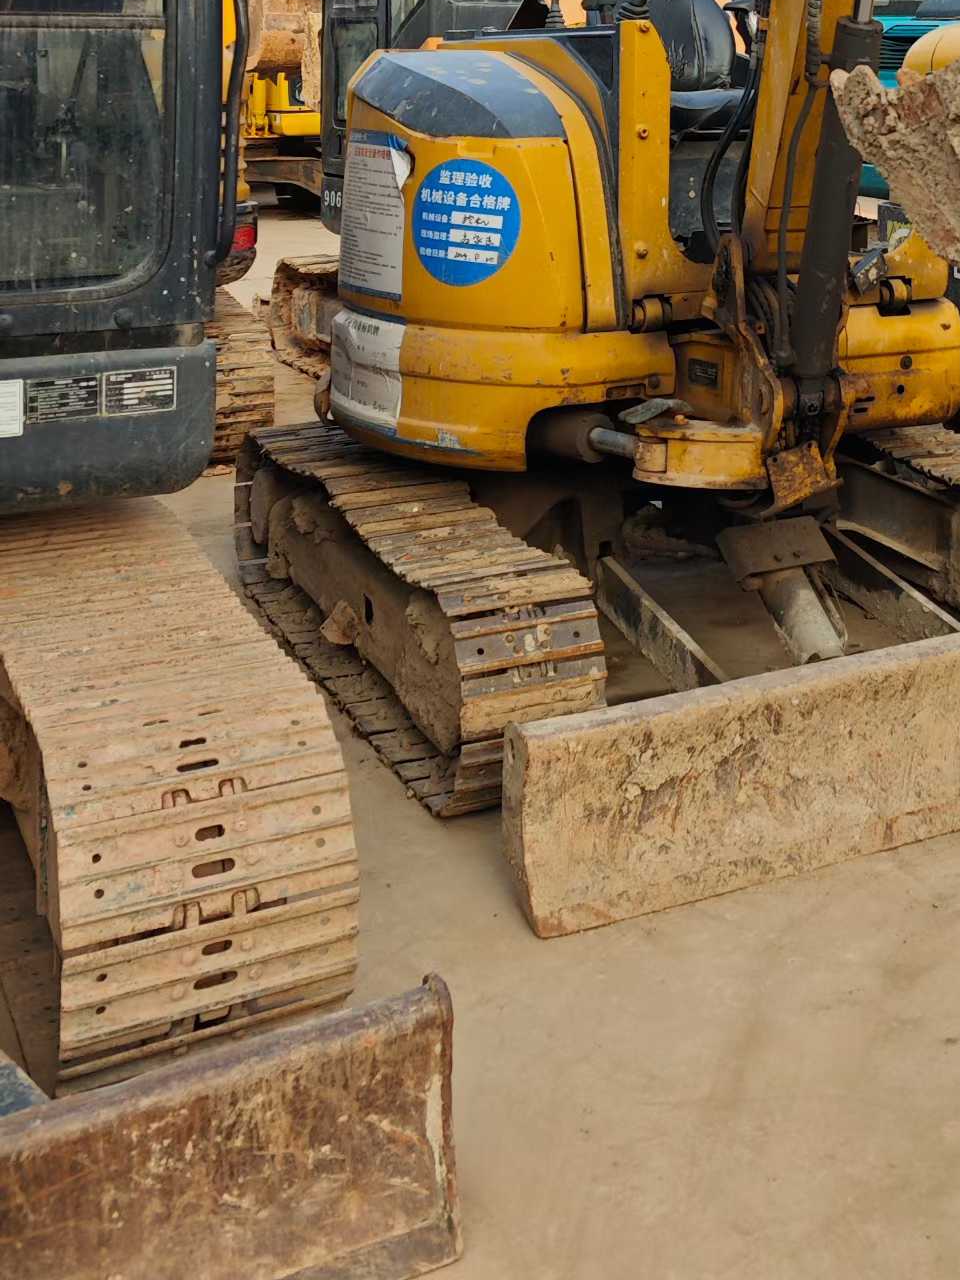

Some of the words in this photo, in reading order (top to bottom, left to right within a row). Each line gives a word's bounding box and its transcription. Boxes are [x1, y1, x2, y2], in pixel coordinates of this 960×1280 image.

[438, 169, 493, 189] 监理验收
[420, 187, 512, 211] 机械设备合格牌
